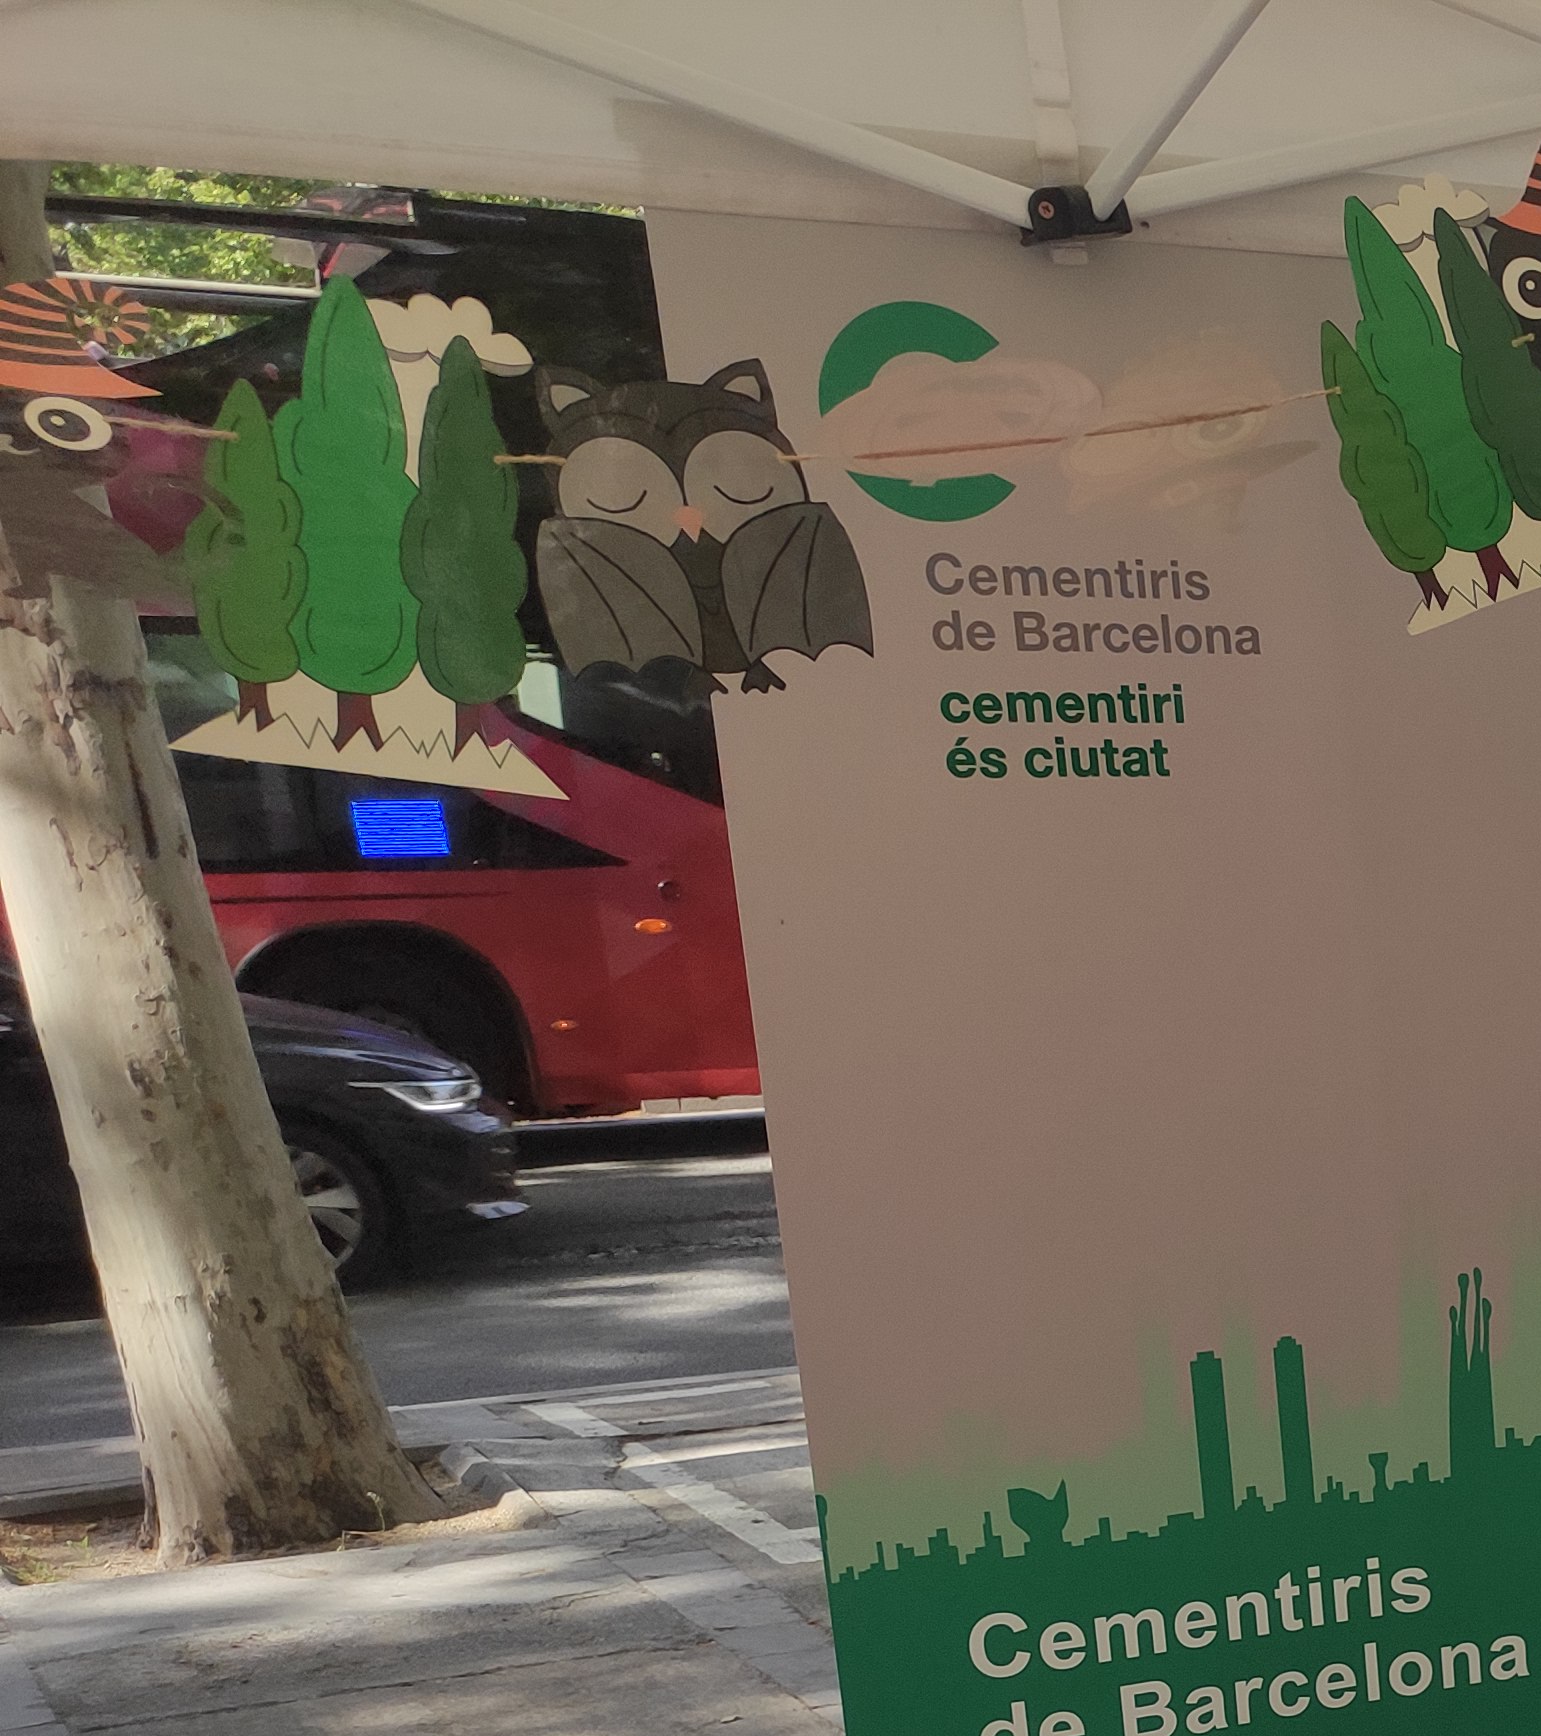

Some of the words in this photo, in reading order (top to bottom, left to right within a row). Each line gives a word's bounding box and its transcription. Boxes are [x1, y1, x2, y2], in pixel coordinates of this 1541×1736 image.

[926, 552, 1210, 600] Cementiris
[932, 611, 996, 651] de
[1013, 611, 1262, 655] Barcelona
[939, 683, 1186, 723] cementiri
[945, 736, 1007, 778] és
[1024, 735, 1170, 777] ciutat
[967, 1557, 1432, 1678] Cementiris
